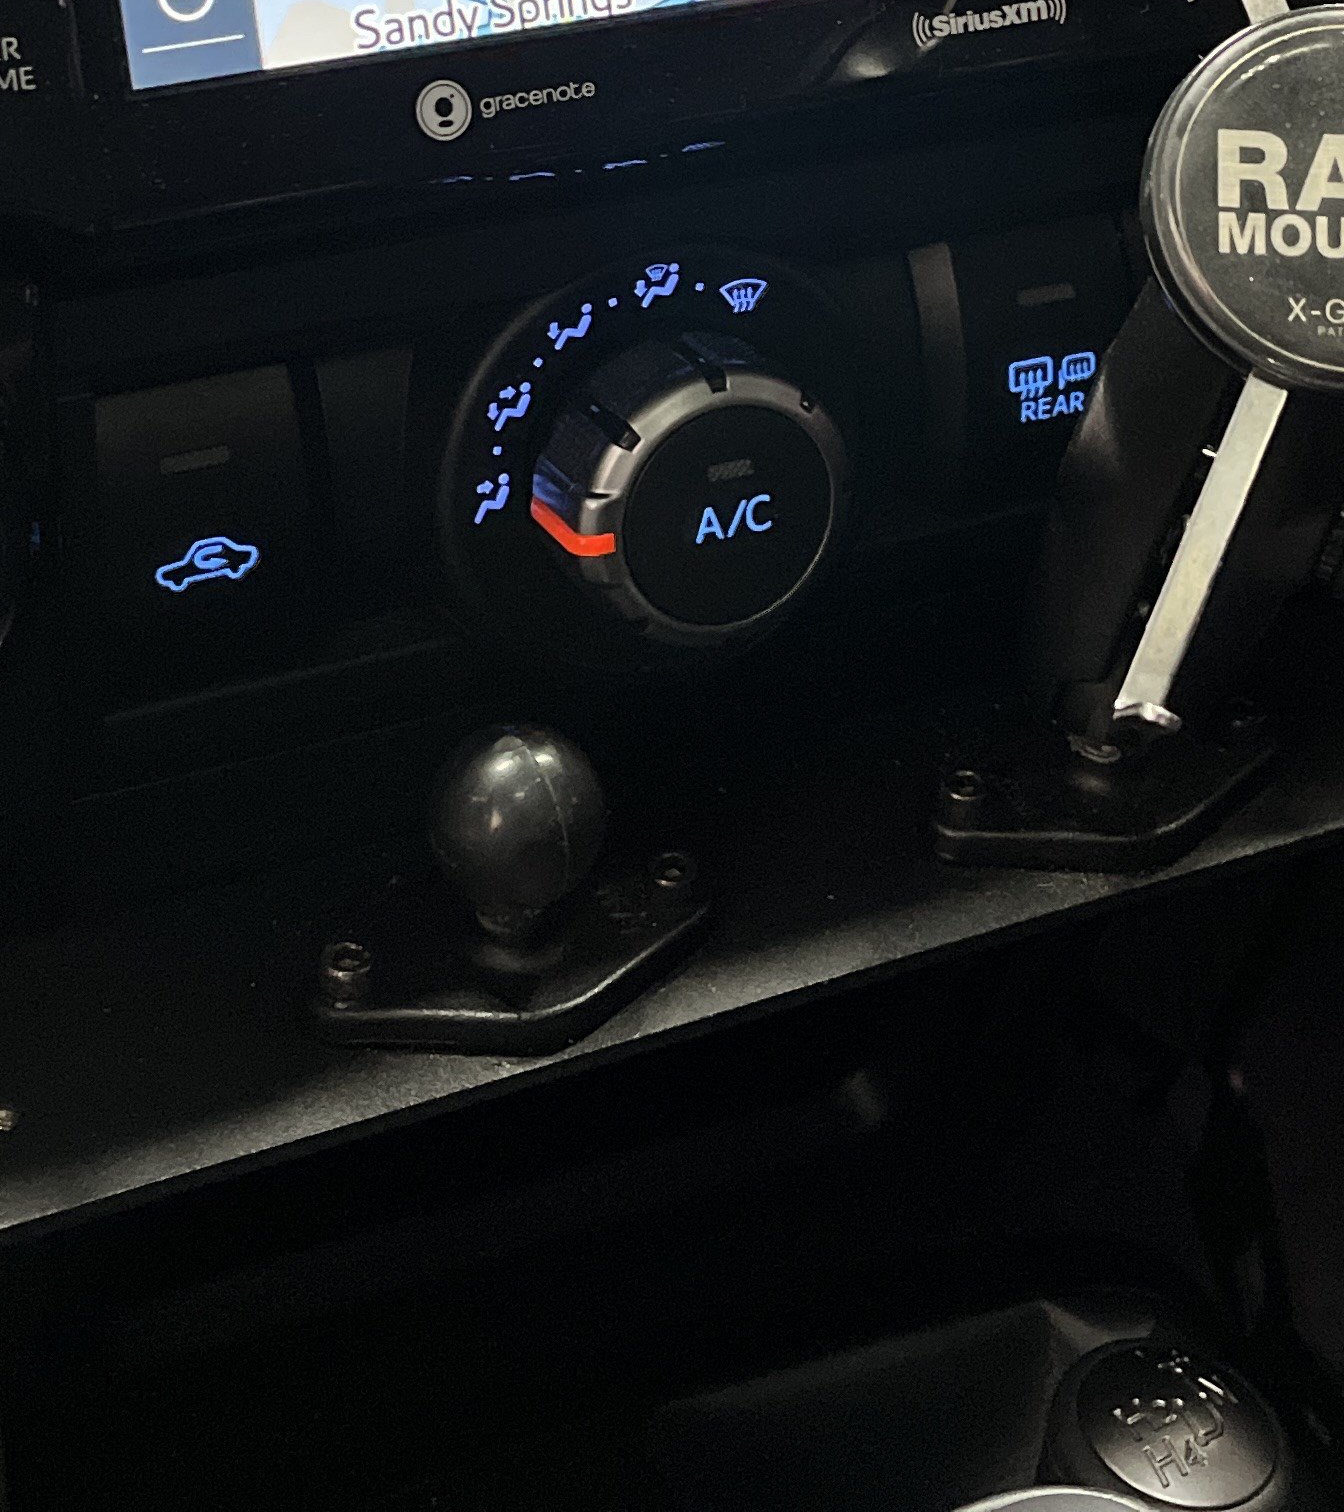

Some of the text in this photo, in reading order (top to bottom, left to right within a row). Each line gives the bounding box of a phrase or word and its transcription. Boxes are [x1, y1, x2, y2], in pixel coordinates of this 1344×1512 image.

[479, 81, 596, 119] gracenote
[1020, 390, 1086, 424] REAR
[695, 493, 774, 544] A/C
